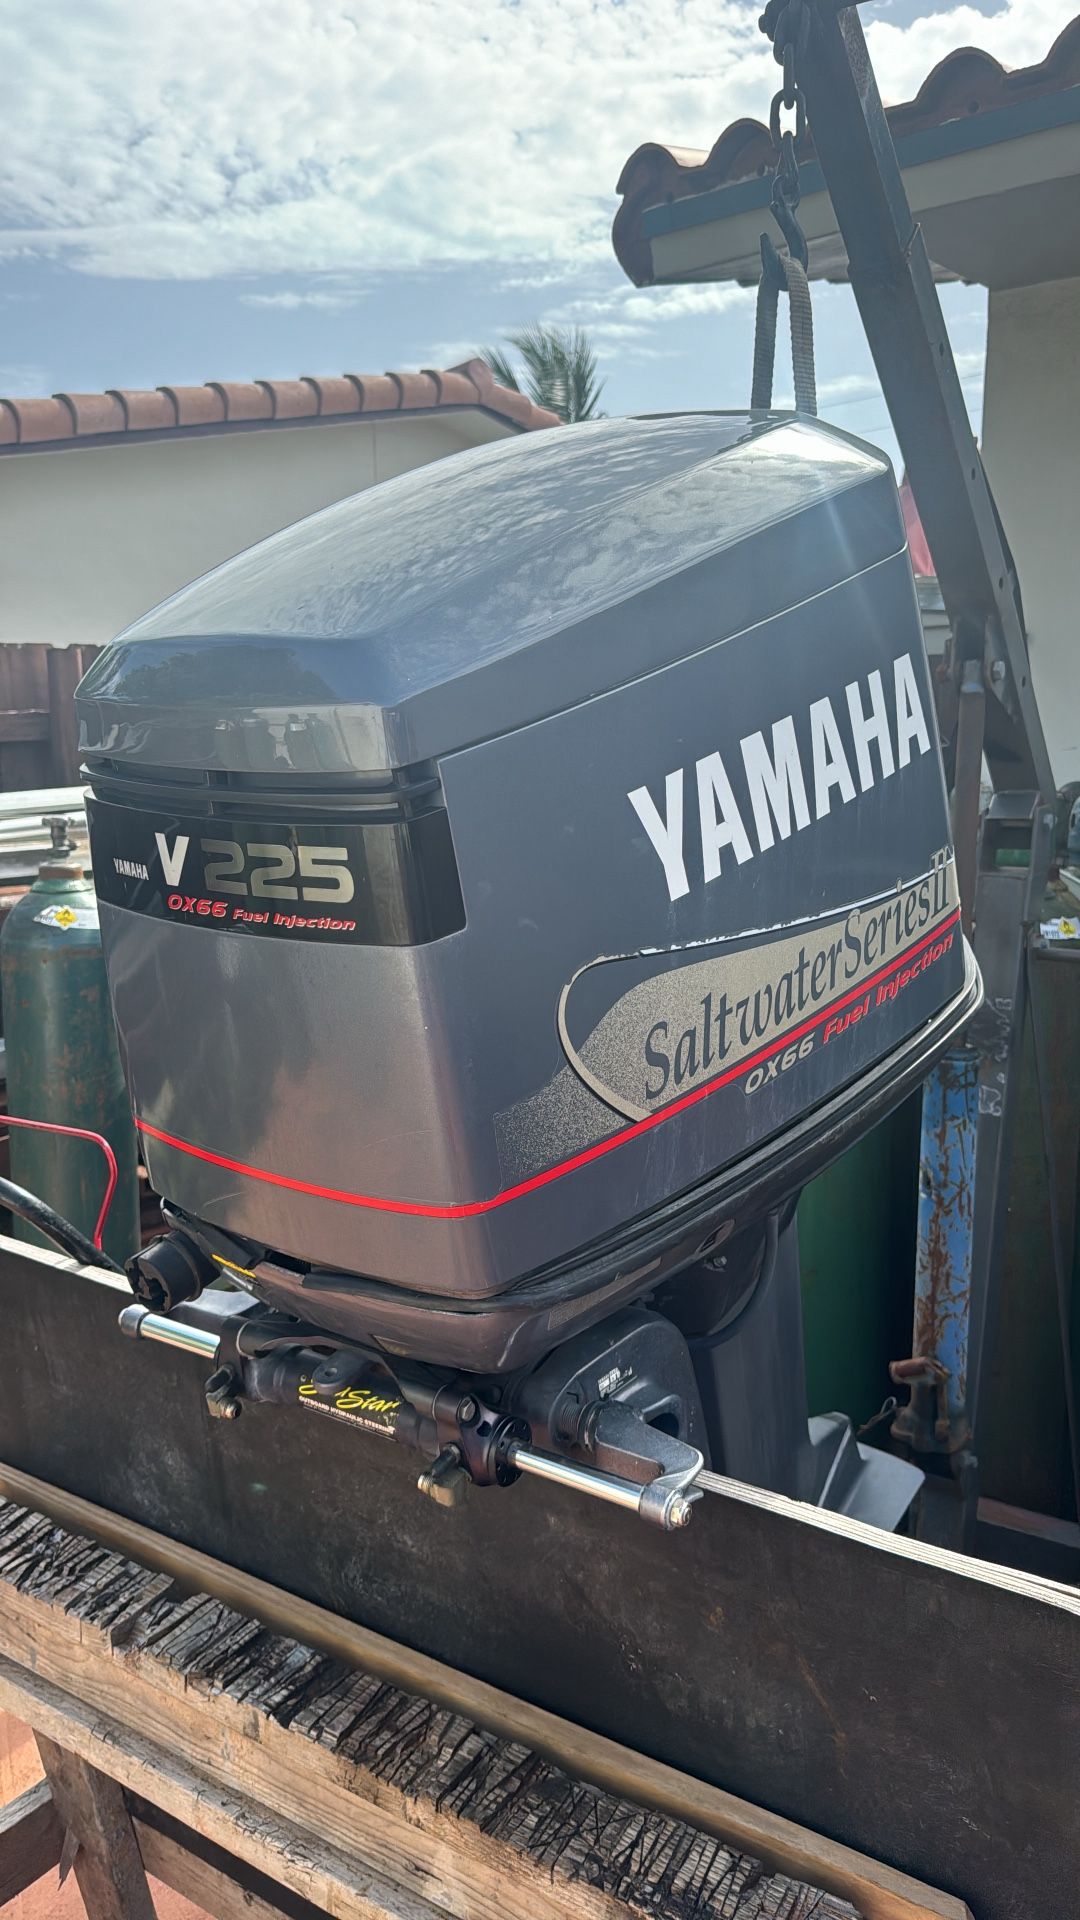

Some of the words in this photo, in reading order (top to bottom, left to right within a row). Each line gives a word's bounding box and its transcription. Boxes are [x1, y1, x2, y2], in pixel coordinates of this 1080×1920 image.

[627, 653, 931, 902] YAMAHA
[113, 858, 149, 880] YAMAHA
[155, 832, 190, 887] V
[201, 838, 355, 904] 225
[168, 894, 228, 917] OX66
[233, 908, 269, 924] Fuel
[274, 911, 356, 931] Injection
[745, 1032, 815, 1096] OX66
[824, 995, 871, 1044] Fuel
[876, 933, 954, 1006] Injection
